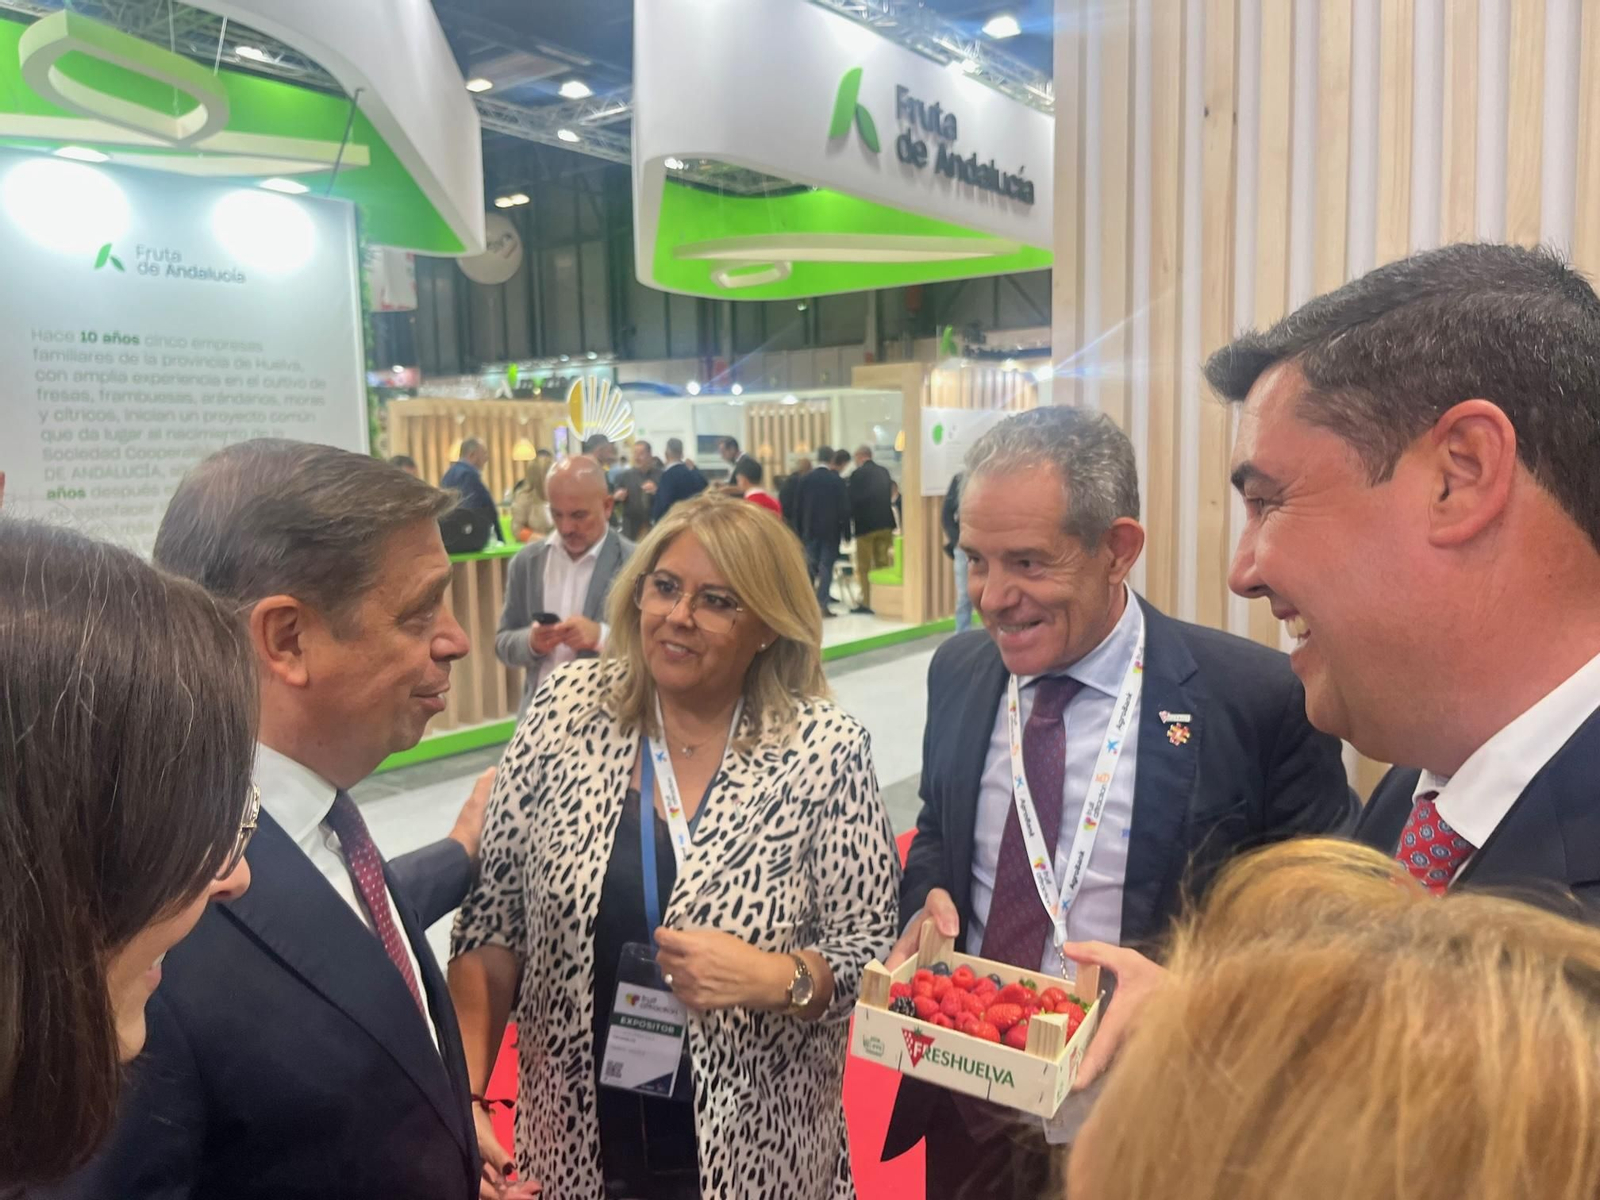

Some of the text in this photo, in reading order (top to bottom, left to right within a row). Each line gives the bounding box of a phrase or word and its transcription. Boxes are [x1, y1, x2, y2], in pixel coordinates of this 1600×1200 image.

[896, 84, 958, 141] Fruta
[896, 128, 1035, 206] de Andalucía
[135, 243, 183, 262] Fruta
[136, 261, 247, 284] de Andalucía
[31, 328, 75, 343] Hace
[80, 330, 98, 344] 10
[102, 330, 140, 345] años
[144, 333, 188, 348] cinco
[33, 347, 114, 364] familiares
[119, 350, 140, 364] de
[144, 351, 157, 365] la
[233, 355, 252, 370] de
[35, 369, 68, 382] con
[73, 369, 128, 385] amplia
[224, 375, 243, 387] en
[309, 378, 327, 390] de
[37, 387, 95, 403] fresas,
[38, 410, 48, 424] y
[179, 410, 200, 423] un
[40, 428, 74, 443] que
[44, 466, 67, 481] DE
[46, 485, 87, 500] años
[620, 1016, 675, 1034] EXPOSITOR
[912, 1041, 1016, 1089] FRESHUELVA
